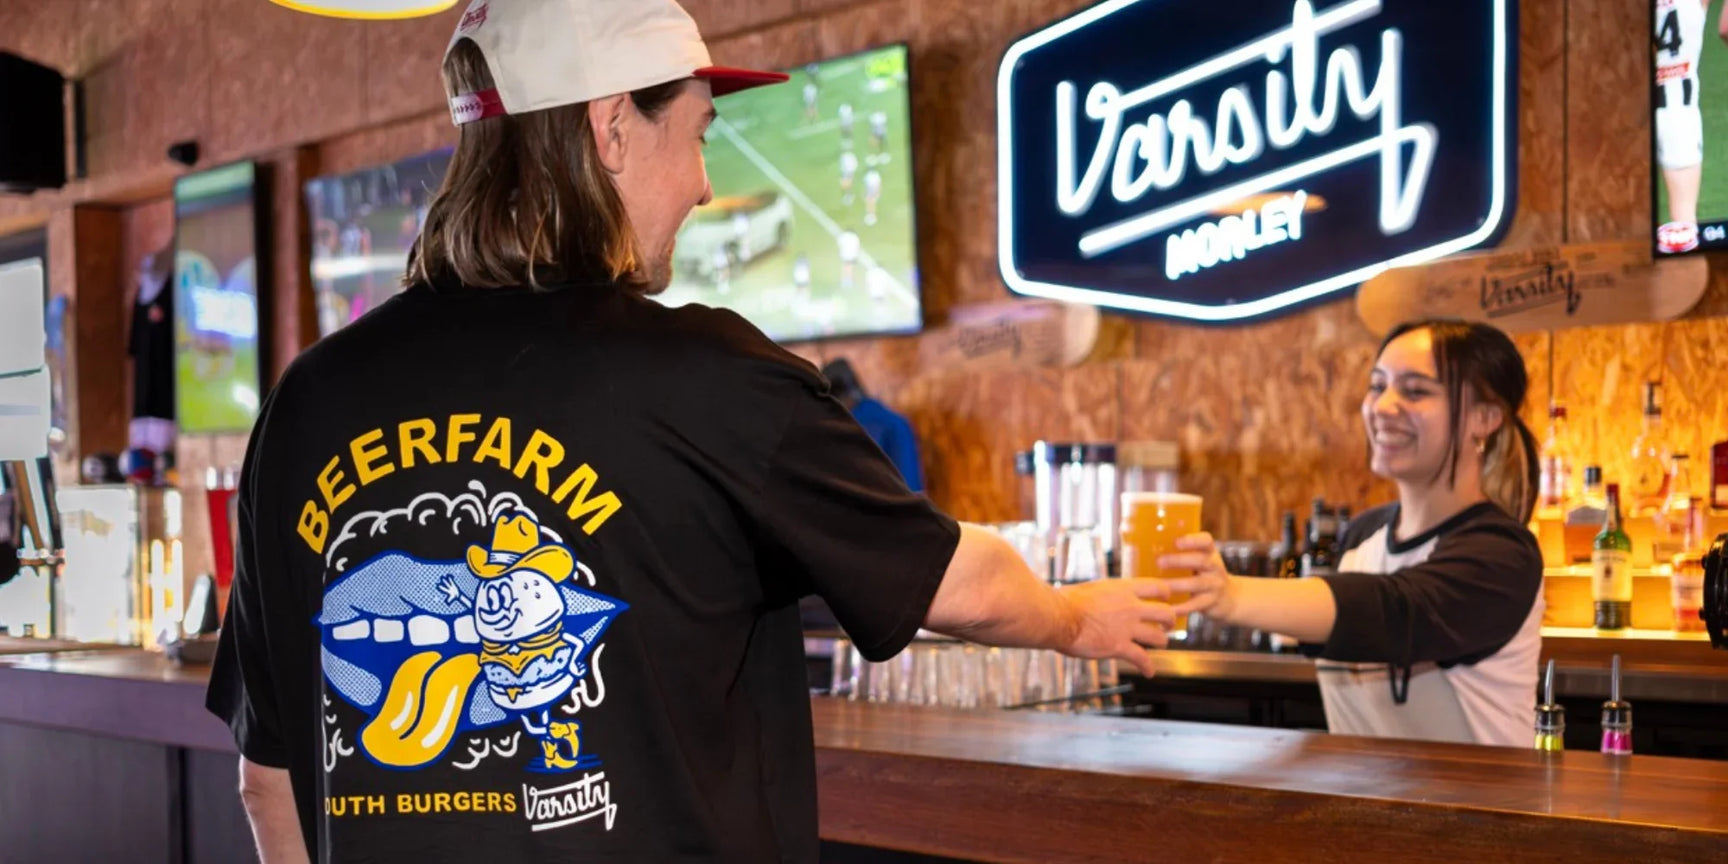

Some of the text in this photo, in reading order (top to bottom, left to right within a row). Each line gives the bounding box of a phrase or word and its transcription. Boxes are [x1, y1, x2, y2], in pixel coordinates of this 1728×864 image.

[1057, 0, 1438, 252] Varsity
[1165, 189, 1308, 280] MORLEY
[297, 413, 623, 554] BEERFARM
[397, 792, 517, 813] BURGERS
[522, 771, 617, 831] Varsity
